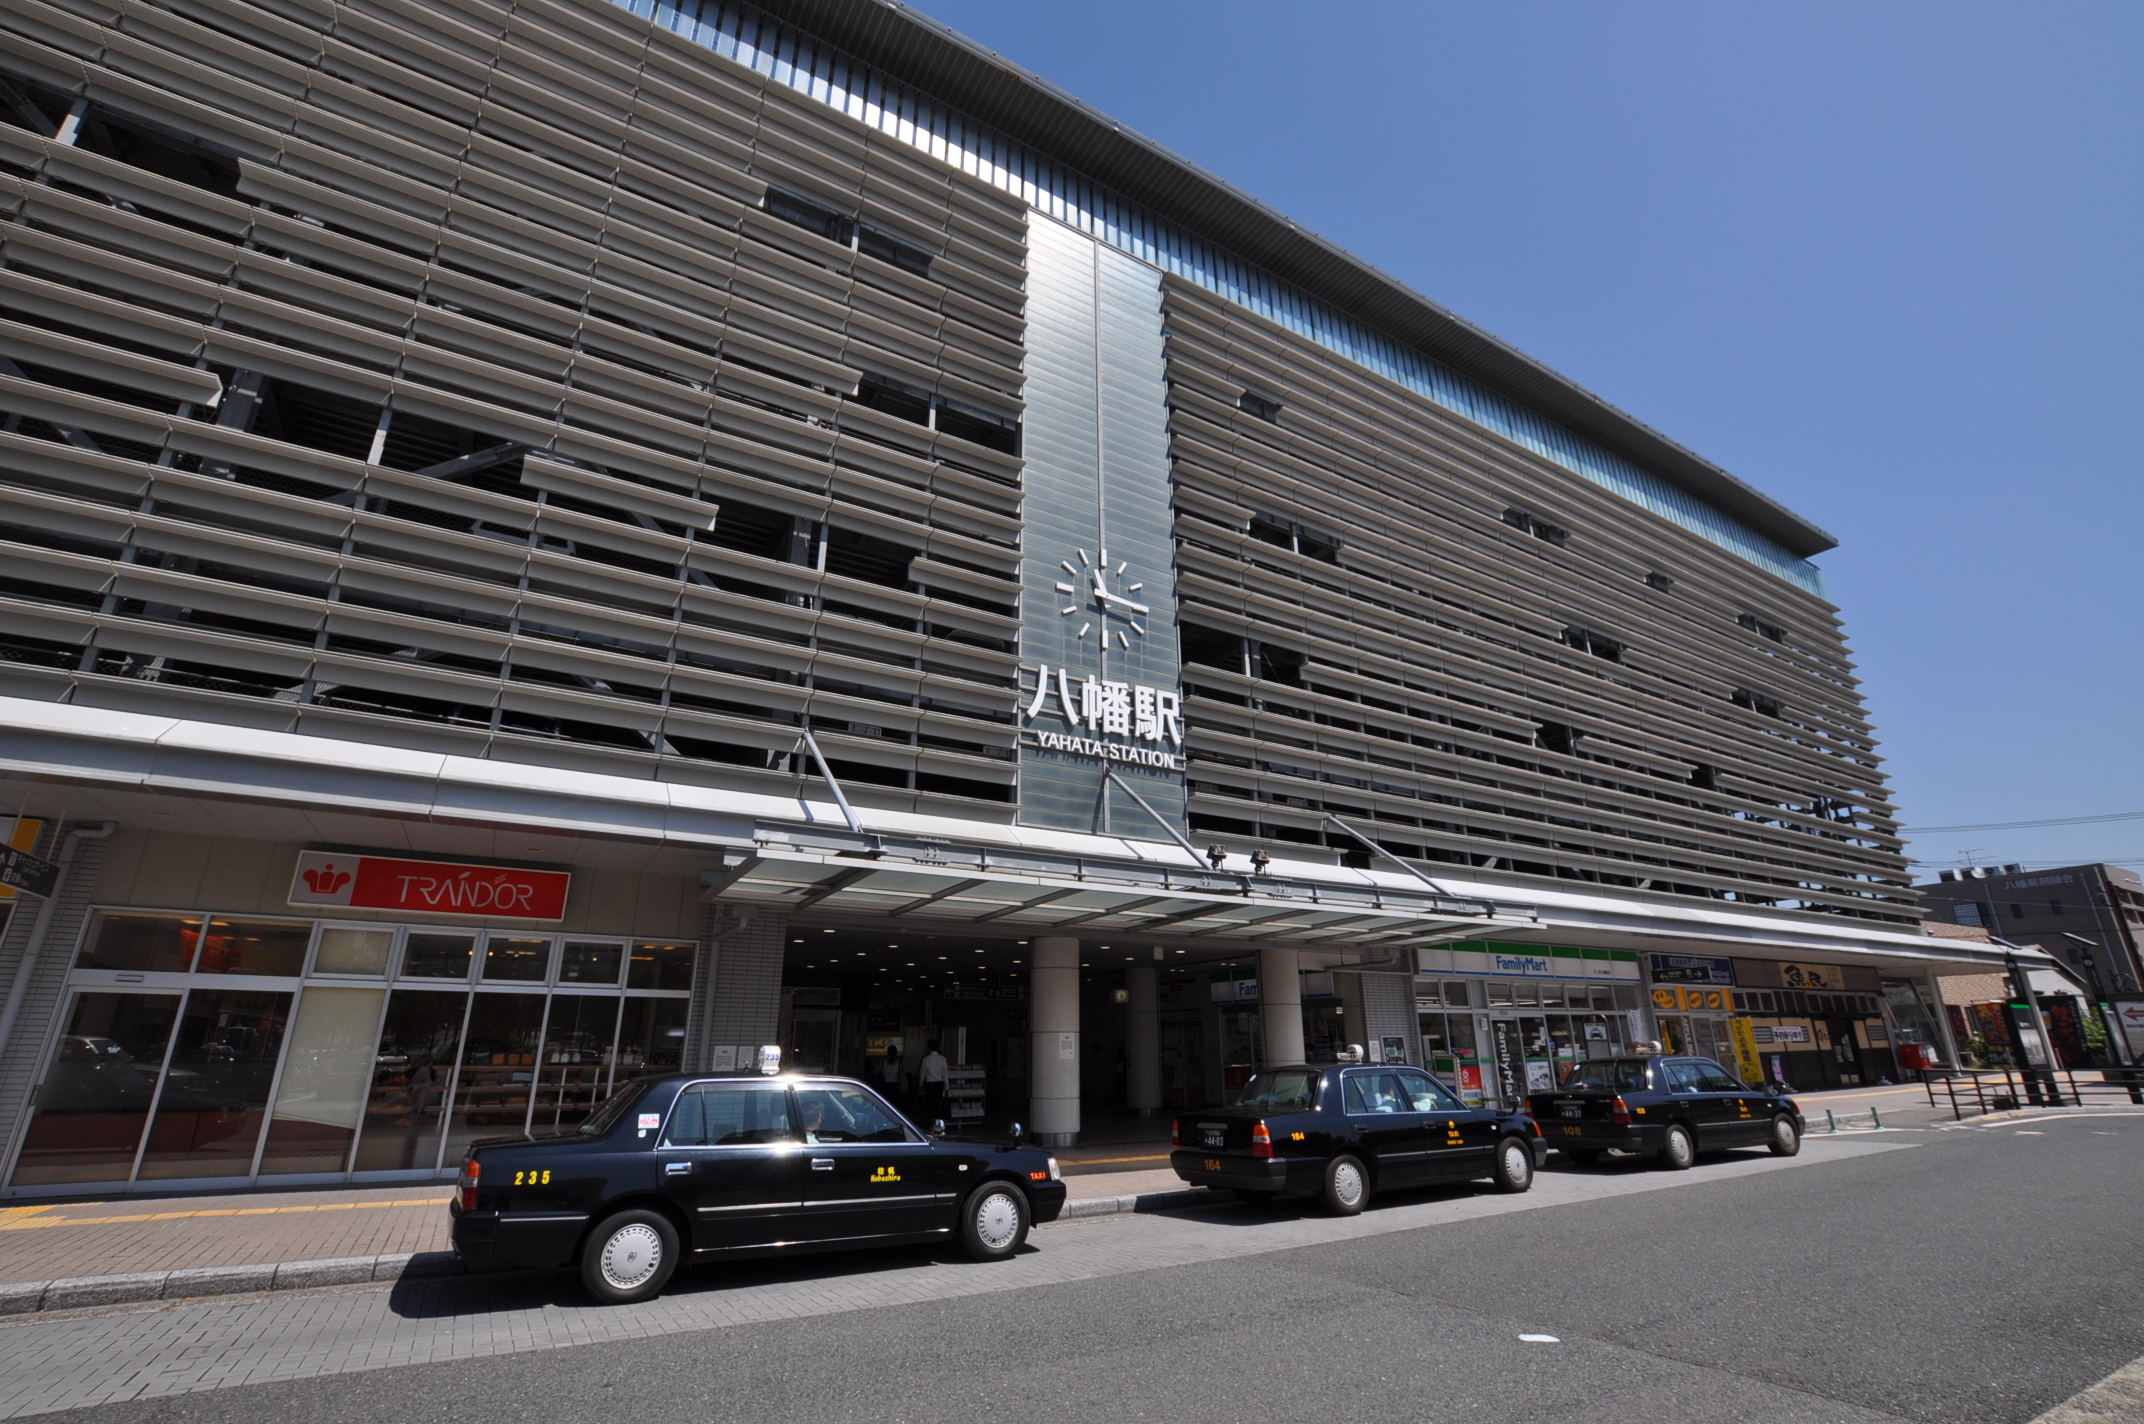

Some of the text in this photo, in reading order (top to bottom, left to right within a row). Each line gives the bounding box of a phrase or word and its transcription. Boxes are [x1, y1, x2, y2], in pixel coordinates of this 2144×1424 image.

[1026, 663, 1182, 746] 八幡駅
[1036, 729, 1175, 769] YAHATA STATION
[1495, 955, 1548, 974] FamilyMart
[766, 1053, 780, 1061] 235
[1497, 1022, 1514, 1097] FamilyMar
[1636, 1107, 1647, 1115] 108
[1291, 1132, 1305, 1141] 164
[1563, 1127, 1582, 1136] 108
[1204, 1159, 1222, 1171] 164
[514, 1170, 551, 1186] 235
[1030, 1172, 1047, 1180] TAXI
